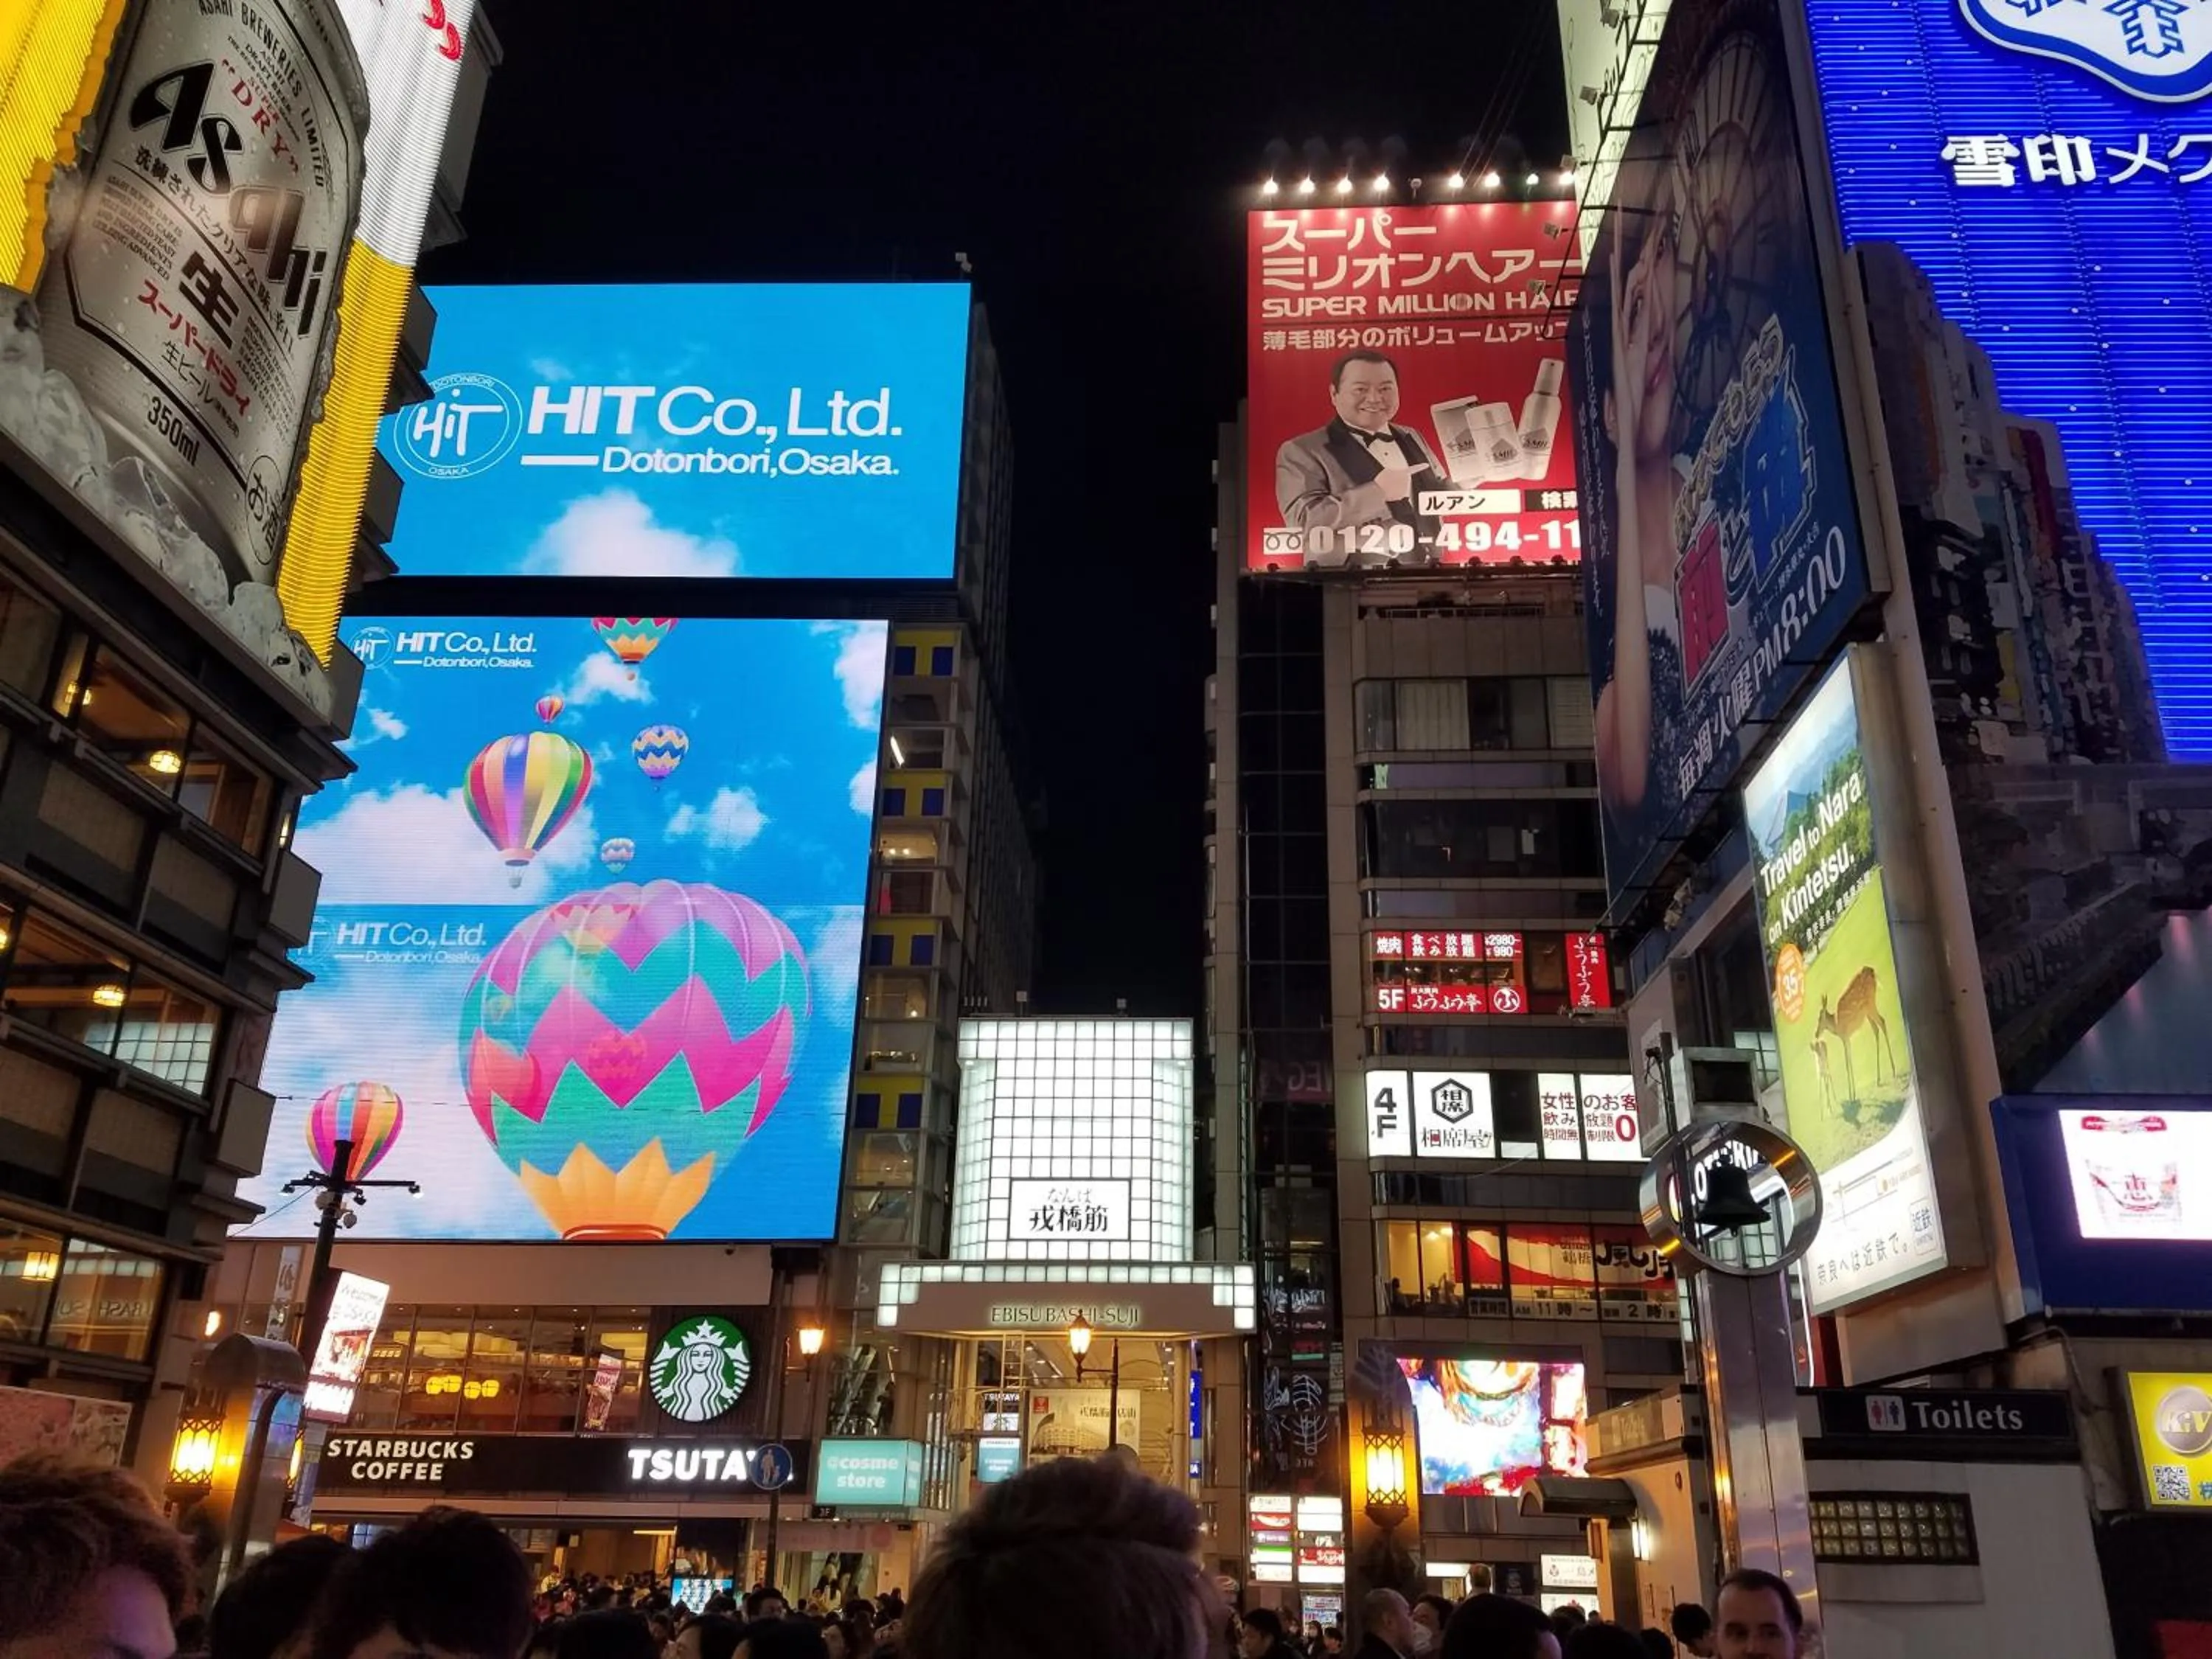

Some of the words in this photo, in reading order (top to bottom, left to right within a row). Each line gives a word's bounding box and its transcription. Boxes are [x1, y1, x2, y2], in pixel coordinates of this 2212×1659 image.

[241, 2, 302, 97] BREWERIES
[301, 108, 324, 187] LIMITED
[1262, 214, 1436, 253] スーパー
[1262, 248, 1584, 291] ミリオンヘアー
[179, 251, 240, 350] 生
[1262, 296, 1367, 318] SUPER
[1378, 293, 1495, 315] MILLION
[137, 278, 251, 417] スーパードライ
[527, 385, 655, 436] HIT
[148, 396, 201, 467] 350ml
[428, 467, 469, 476] OSAKA
[1425, 495, 1486, 511] ルアン
[395, 632, 445, 653] HIT
[1760, 825, 1806, 897] Travel
[1807, 827, 1820, 850] to
[1818, 772, 1863, 837] Nara
[1769, 920, 1782, 945] on
[1781, 843, 1855, 930] Kintetsu.
[336, 922, 389, 945] HIT
[1378, 989, 1404, 1009] 5F
[1374, 1087, 1397, 1139] 4F
[1029, 1204, 1109, 1232] 戎橋筋
[1910, 1399, 2024, 1430] Toilets
[327, 1439, 476, 1460] STARBUCKS
[627, 1447, 794, 1481] TSUTA
[351, 1461, 445, 1481] COFFEE
[837, 1473, 886, 1489] store
